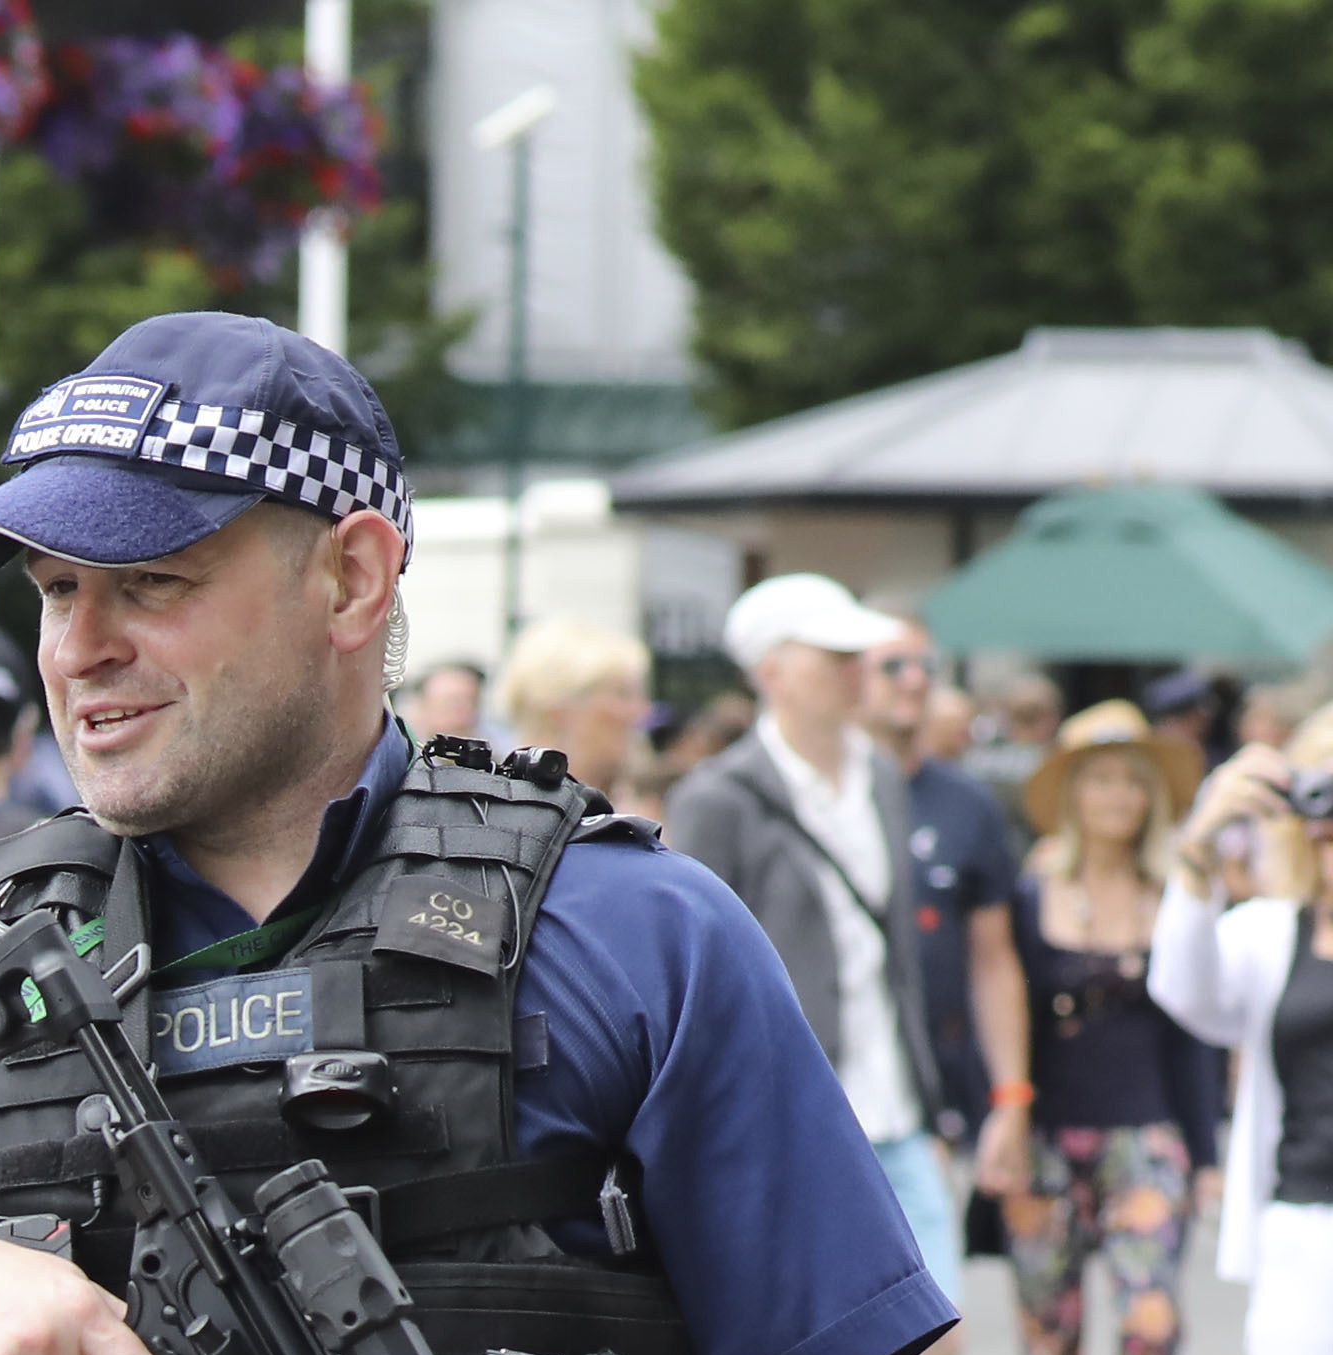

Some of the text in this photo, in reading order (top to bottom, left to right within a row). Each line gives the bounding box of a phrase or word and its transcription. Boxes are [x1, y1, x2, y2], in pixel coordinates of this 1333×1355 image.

[72, 398, 131, 414] POLICE
[10, 424, 139, 456] POLICE OFFICER
[429, 892, 474, 920] CO
[408, 912, 483, 946] 4224
[228, 936, 266, 961] THE
